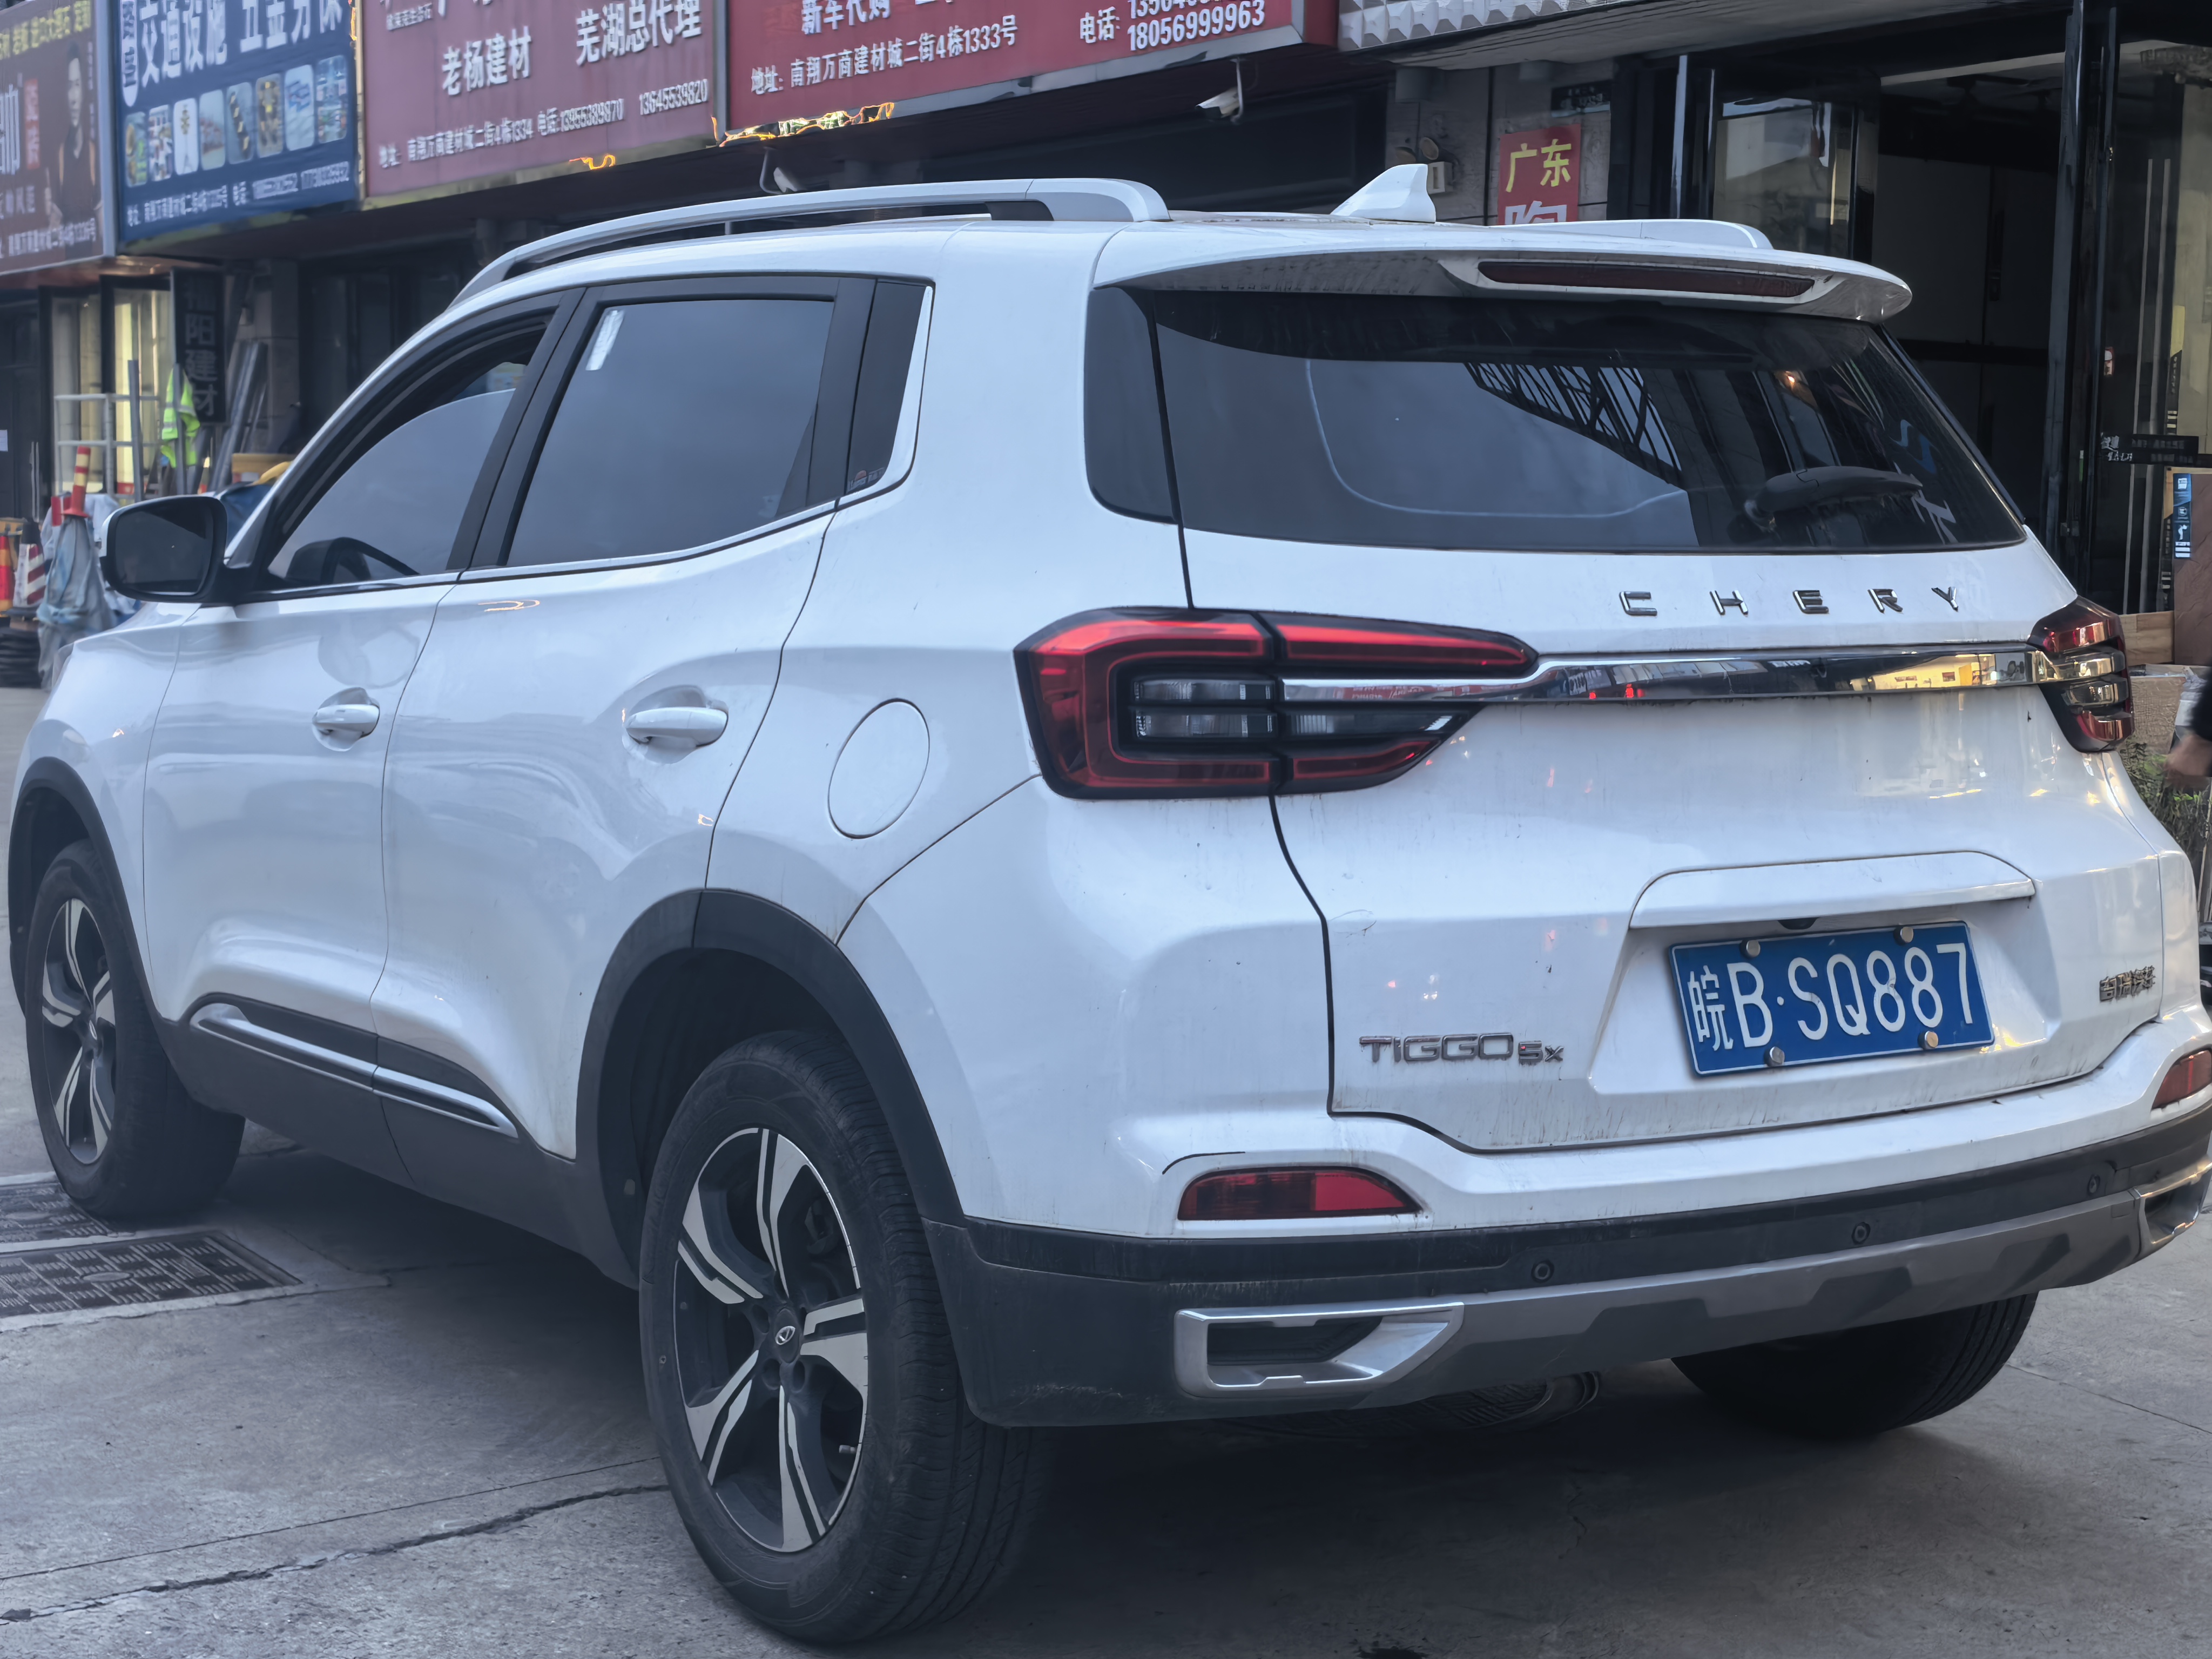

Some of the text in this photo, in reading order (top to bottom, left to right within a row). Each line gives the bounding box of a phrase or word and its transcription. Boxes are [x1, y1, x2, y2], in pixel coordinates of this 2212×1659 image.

[576, 0, 702, 66] 芜湖总代理
[1127, 0, 1265, 51] 18056999963
[442, 25, 532, 96] 老杨建材
[1506, 138, 1572, 192] 广东
[1619, 586, 1958, 617] CHERY
[1359, 1032, 1514, 1062] TIGGO
